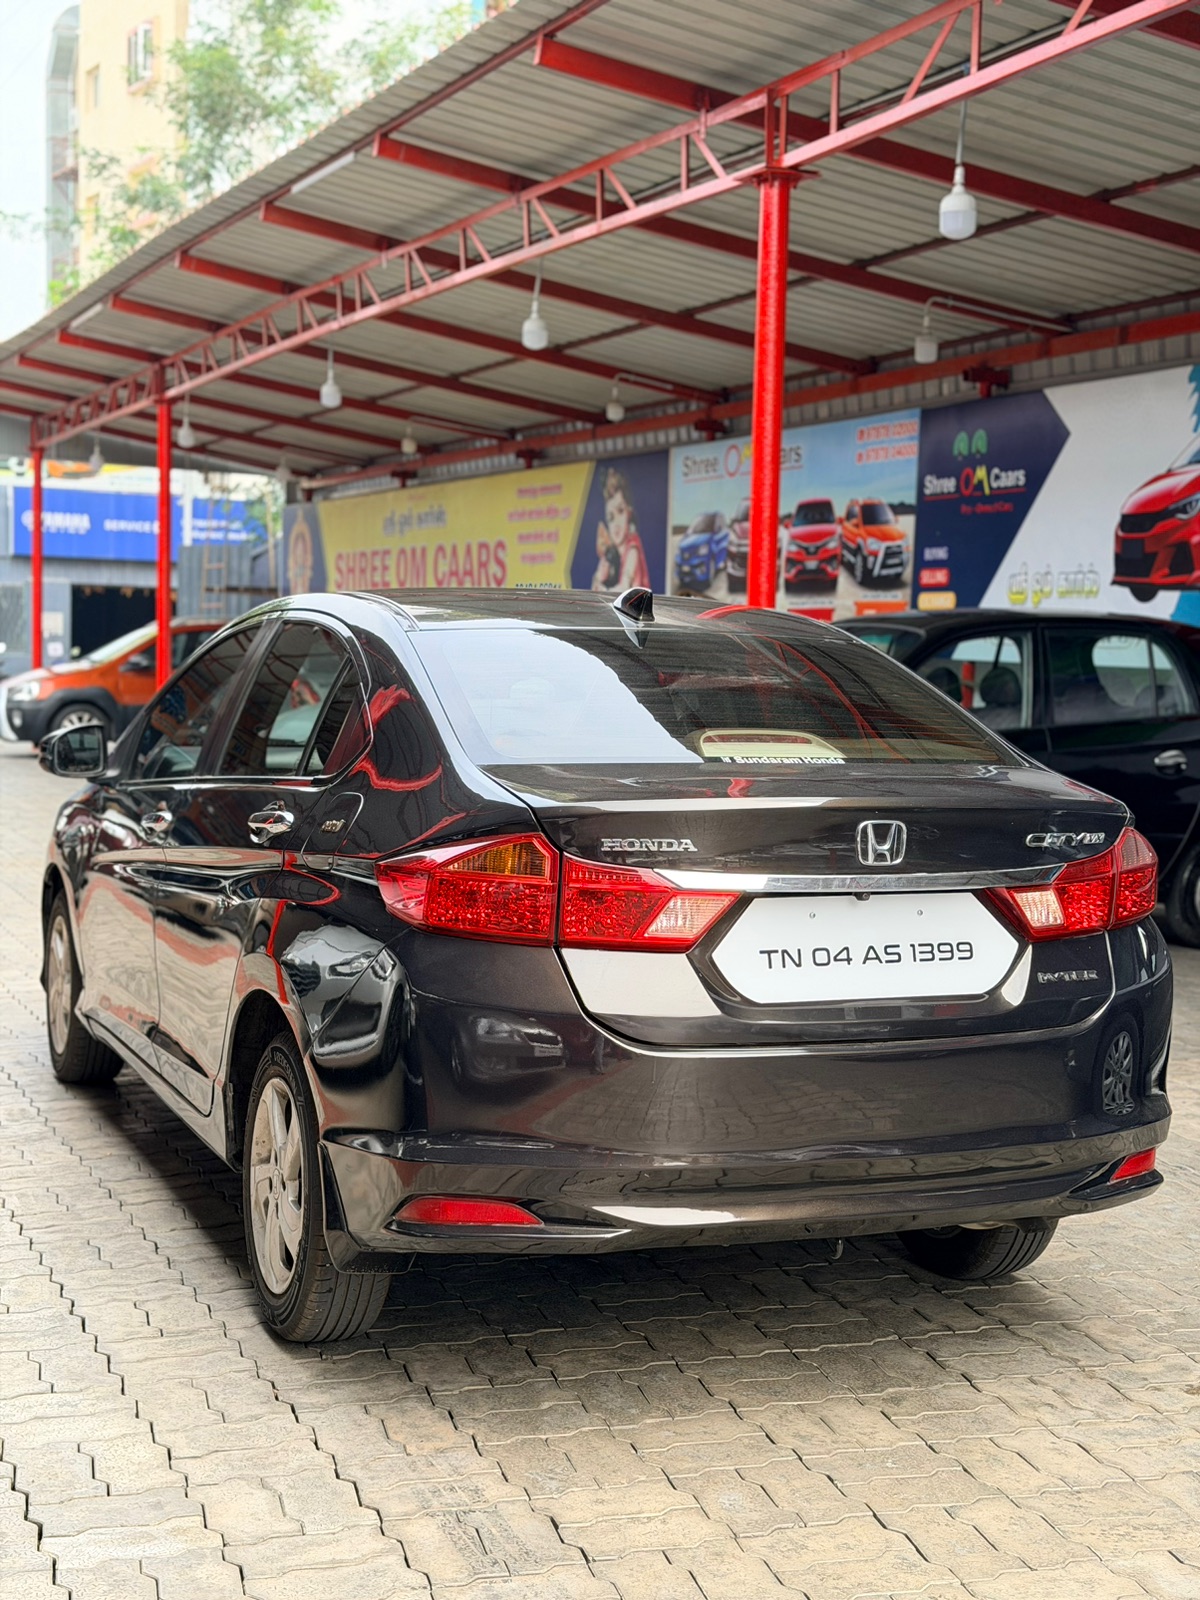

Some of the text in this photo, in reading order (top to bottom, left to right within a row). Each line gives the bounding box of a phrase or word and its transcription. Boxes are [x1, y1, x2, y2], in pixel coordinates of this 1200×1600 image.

[923, 464, 1026, 497] Shree OM Caars
[334, 539, 507, 590] SHREE OM CAARS
[733, 756, 846, 764] Sundaram Honda
[601, 838, 698, 852] HONDA
[759, 941, 974, 969] TN 04 AS 1399
